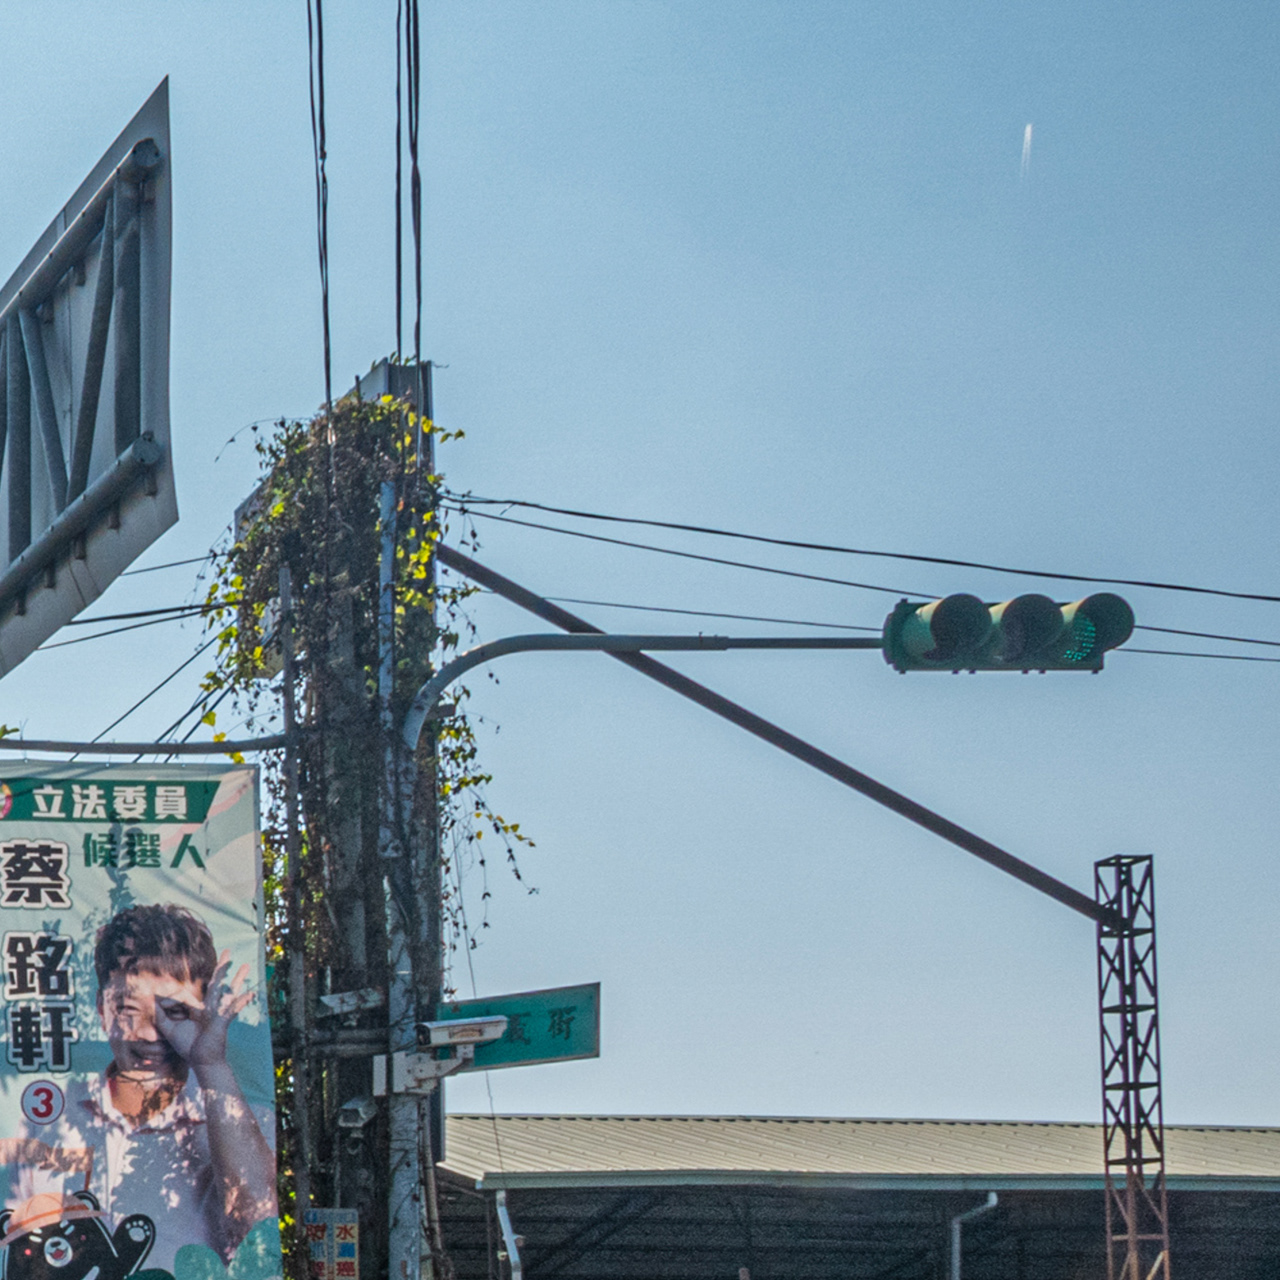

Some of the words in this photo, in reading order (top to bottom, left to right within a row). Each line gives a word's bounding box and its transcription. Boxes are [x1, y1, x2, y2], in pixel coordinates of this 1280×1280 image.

[32, 783, 188, 820] 立法委員
[82, 833, 206, 869] 候選人
[1, 842, 75, 1068] 蔡銘軒
[30, 1087, 55, 1119] 3
